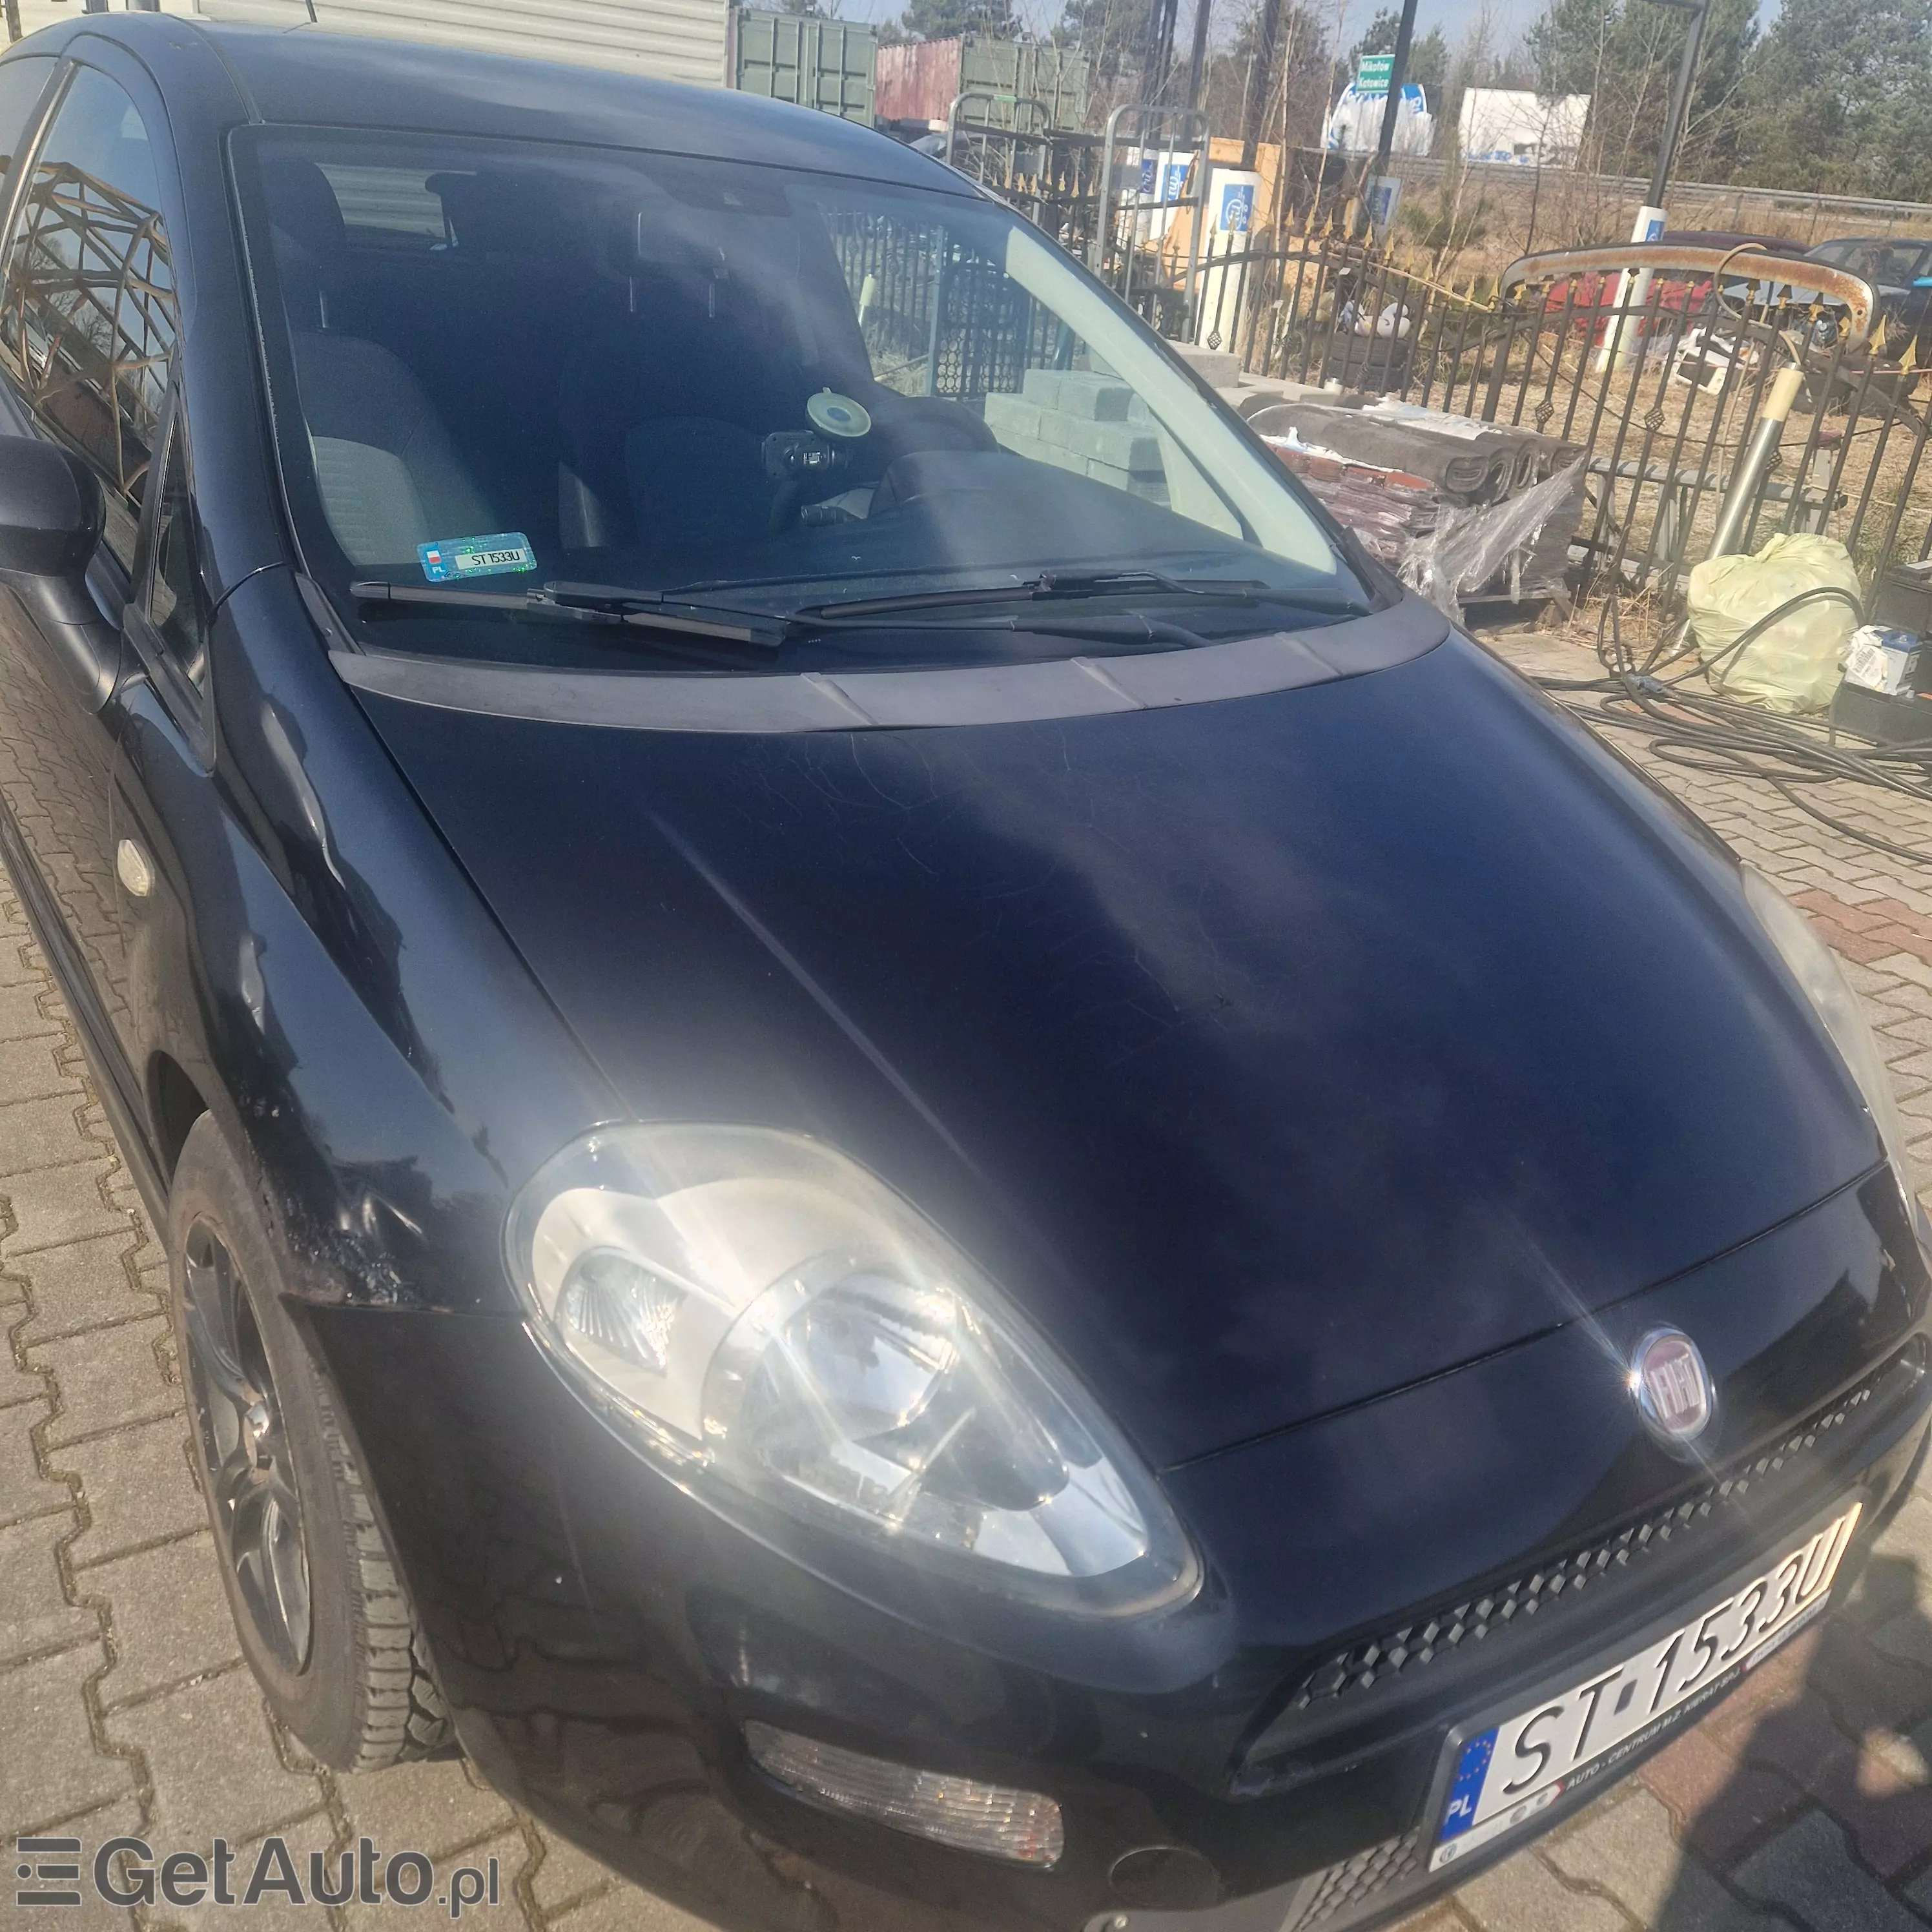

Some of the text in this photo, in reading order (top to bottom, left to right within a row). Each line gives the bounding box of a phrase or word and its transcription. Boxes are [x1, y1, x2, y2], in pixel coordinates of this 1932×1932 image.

[432, 566, 446, 574] PL
[488, 550, 520, 564] 1533U
[1647, 1515, 1848, 1716] 1533U
[1565, 1762, 1600, 1791] AUTO
[1607, 1723, 1661, 1765] CENTRUM
[1444, 1793, 1472, 1826] PL
